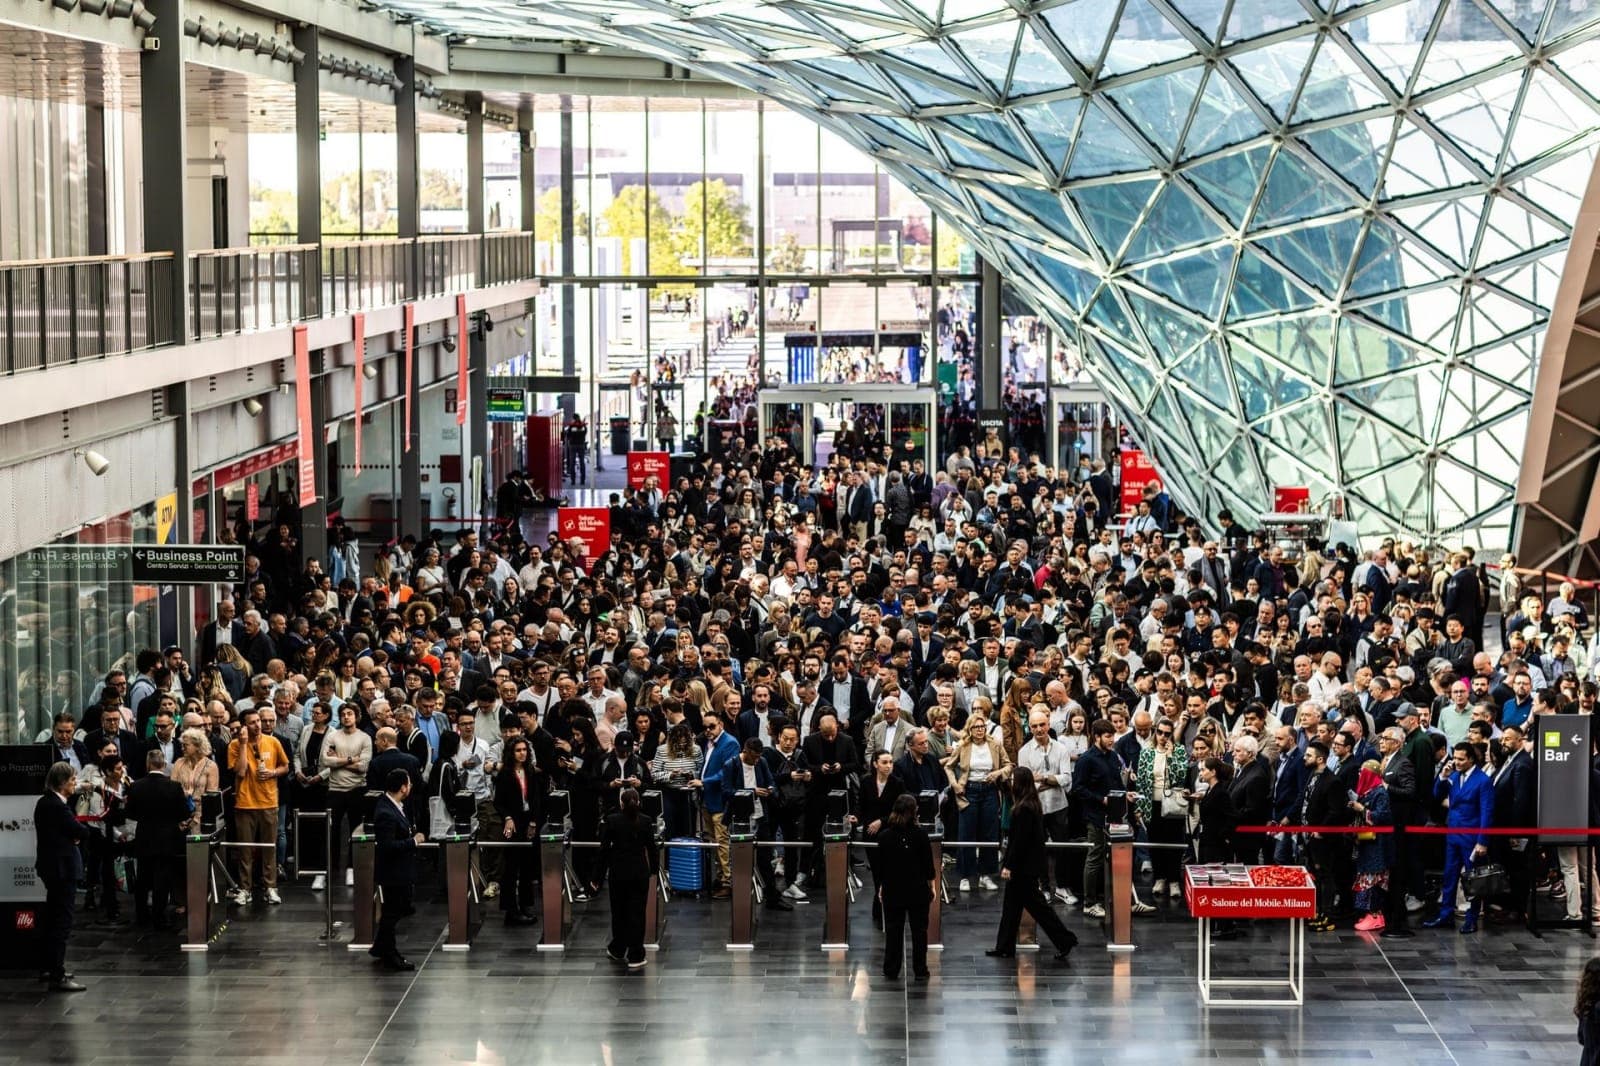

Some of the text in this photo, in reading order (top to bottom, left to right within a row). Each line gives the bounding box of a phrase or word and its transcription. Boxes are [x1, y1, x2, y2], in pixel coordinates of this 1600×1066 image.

[161, 505, 173, 525] ATM
[146, 550, 238, 562] Business Point
[1545, 749, 1570, 761] Bar
[1211, 898, 1239, 907] Salone
[1240, 897, 1253, 907] del
[16, 913, 34, 926] illy
